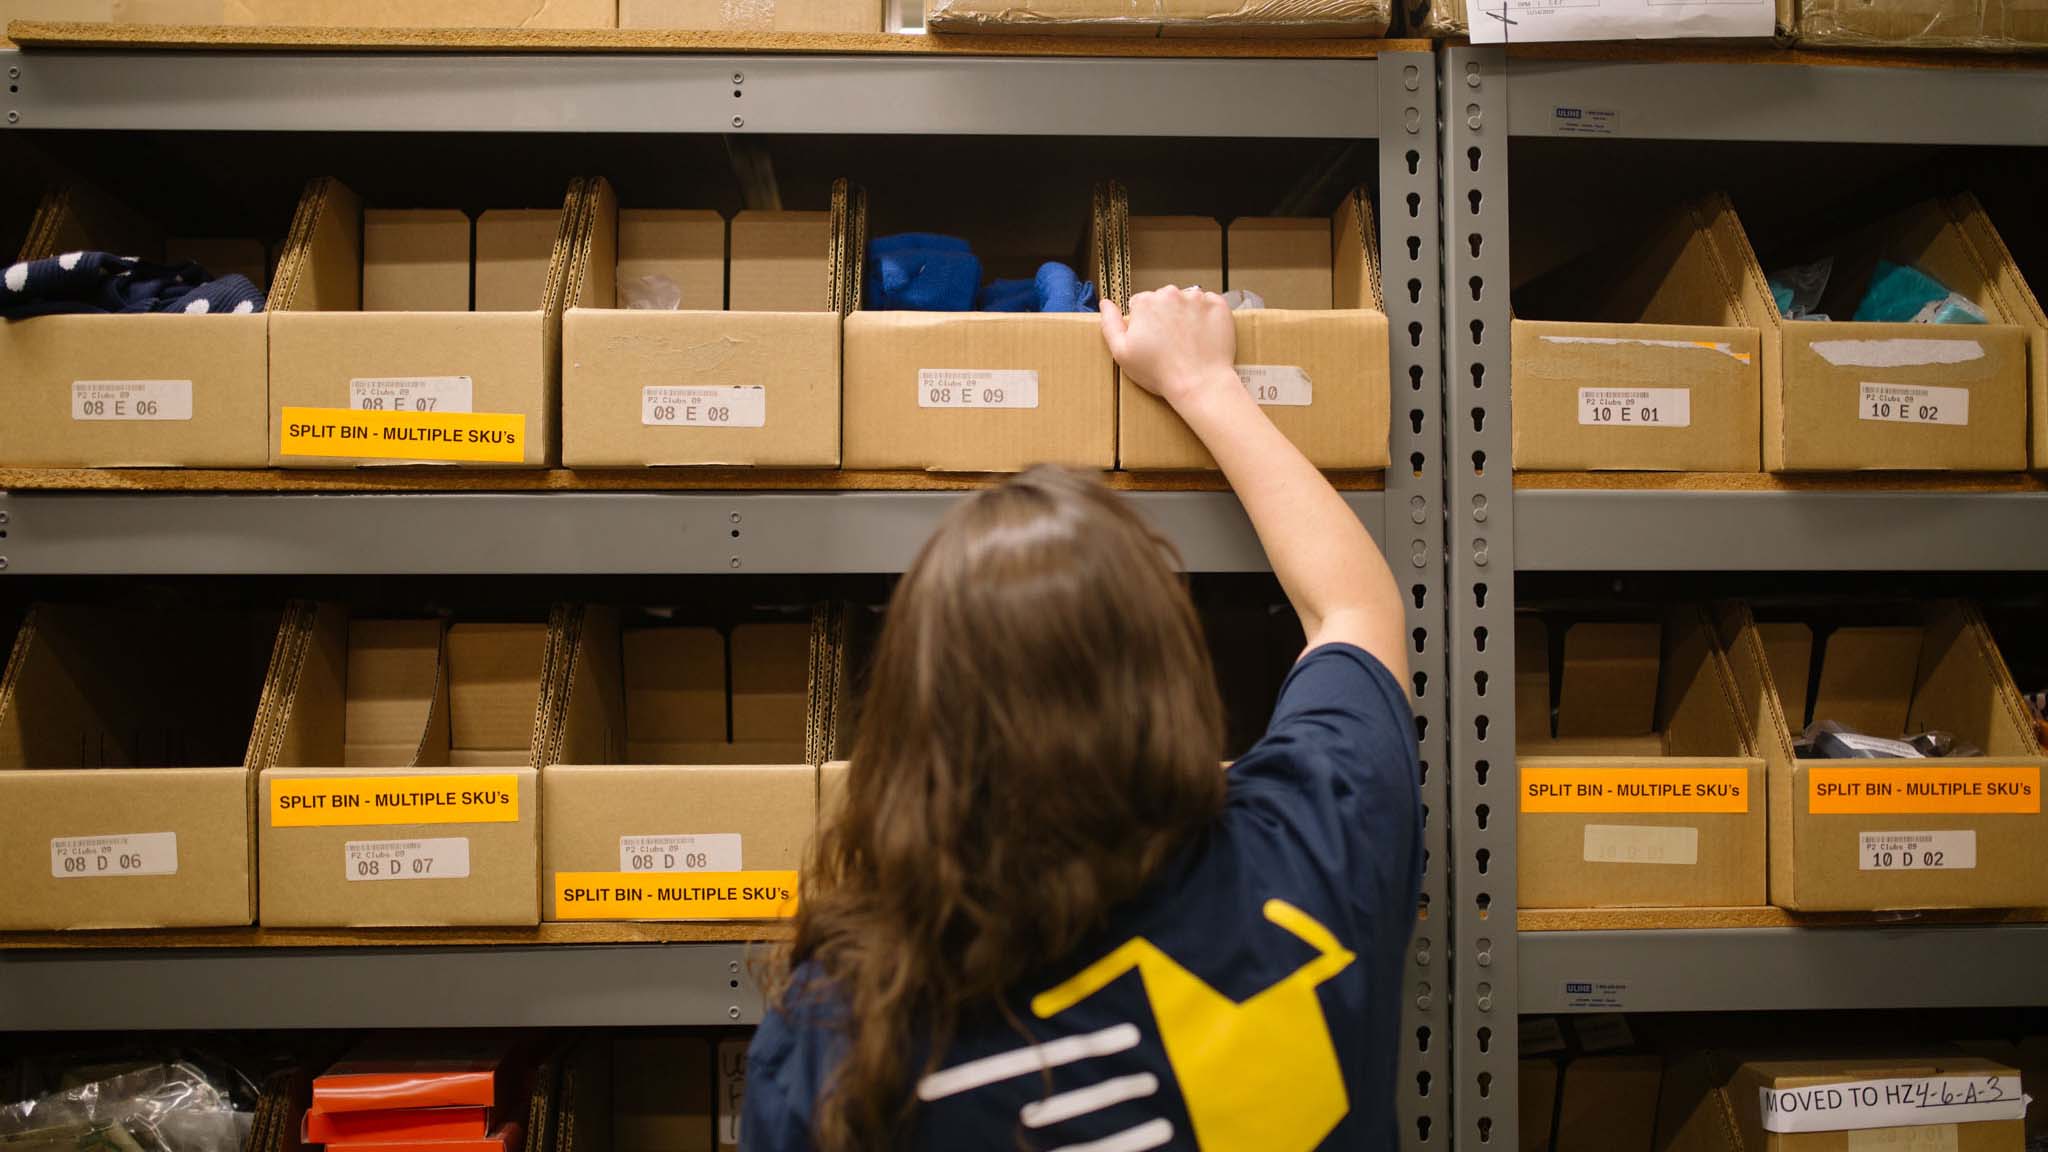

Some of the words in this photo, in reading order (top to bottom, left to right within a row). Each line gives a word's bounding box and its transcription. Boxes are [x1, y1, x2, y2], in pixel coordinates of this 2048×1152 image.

[930, 389, 950, 402] 08
[962, 389, 972, 402] E
[983, 389, 1003, 402] 09
[1258, 386, 1278, 400] 10
[83, 400, 104, 415] 08
[115, 401, 125, 415] E
[136, 400, 157, 415] 06
[363, 398, 383, 411] 08
[416, 398, 437, 411] 07
[1872, 403, 1890, 417] 10
[1900, 405, 1909, 418] E
[1920, 406, 1938, 420] 02
[654, 406, 675, 420] 08
[687, 407, 696, 420] E
[708, 407, 729, 421] 08
[1593, 408, 1611, 421] 10
[1622, 408, 1631, 421] E
[1641, 408, 1659, 421] 01
[289, 424, 335, 438] SPLIT
[340, 426, 368, 439] BIN
[383, 427, 463, 442] MULTIPLE
[468, 430, 515, 443] SKU's
[1529, 784, 1572, 796] SPLIT
[1577, 784, 1603, 796] BIN
[1617, 784, 1691, 796] MULTIPLE
[1696, 784, 1740, 796] SKU's
[1817, 783, 1861, 795] SPLIT
[1866, 784, 1892, 795] BIN
[1907, 783, 1981, 795] MULTIPLE
[1987, 783, 2031, 795] SKU's
[280, 795, 326, 809] SPLIT
[332, 794, 360, 808] BIN
[375, 793, 456, 806] MULTIPLE
[462, 791, 509, 805] SKU's
[64, 857, 85, 872] 08
[97, 856, 108, 870] D
[120, 854, 141, 869] 06
[358, 860, 379, 875] 08
[391, 860, 400, 874] D
[413, 858, 433, 873] 07
[632, 855, 653, 869] 08
[665, 854, 674, 868] D
[686, 853, 706, 868] 08
[1873, 852, 1892, 867] 10
[1904, 852, 1912, 866] D
[1924, 852, 1944, 866] 02
[564, 888, 610, 901] SPLIT
[615, 888, 642, 900] BIN
[658, 887, 737, 900] MULTIPLE
[742, 887, 789, 900] SKU's
[1766, 1089, 1842, 1113] MOVED
[1848, 1087, 1877, 1107] TO
